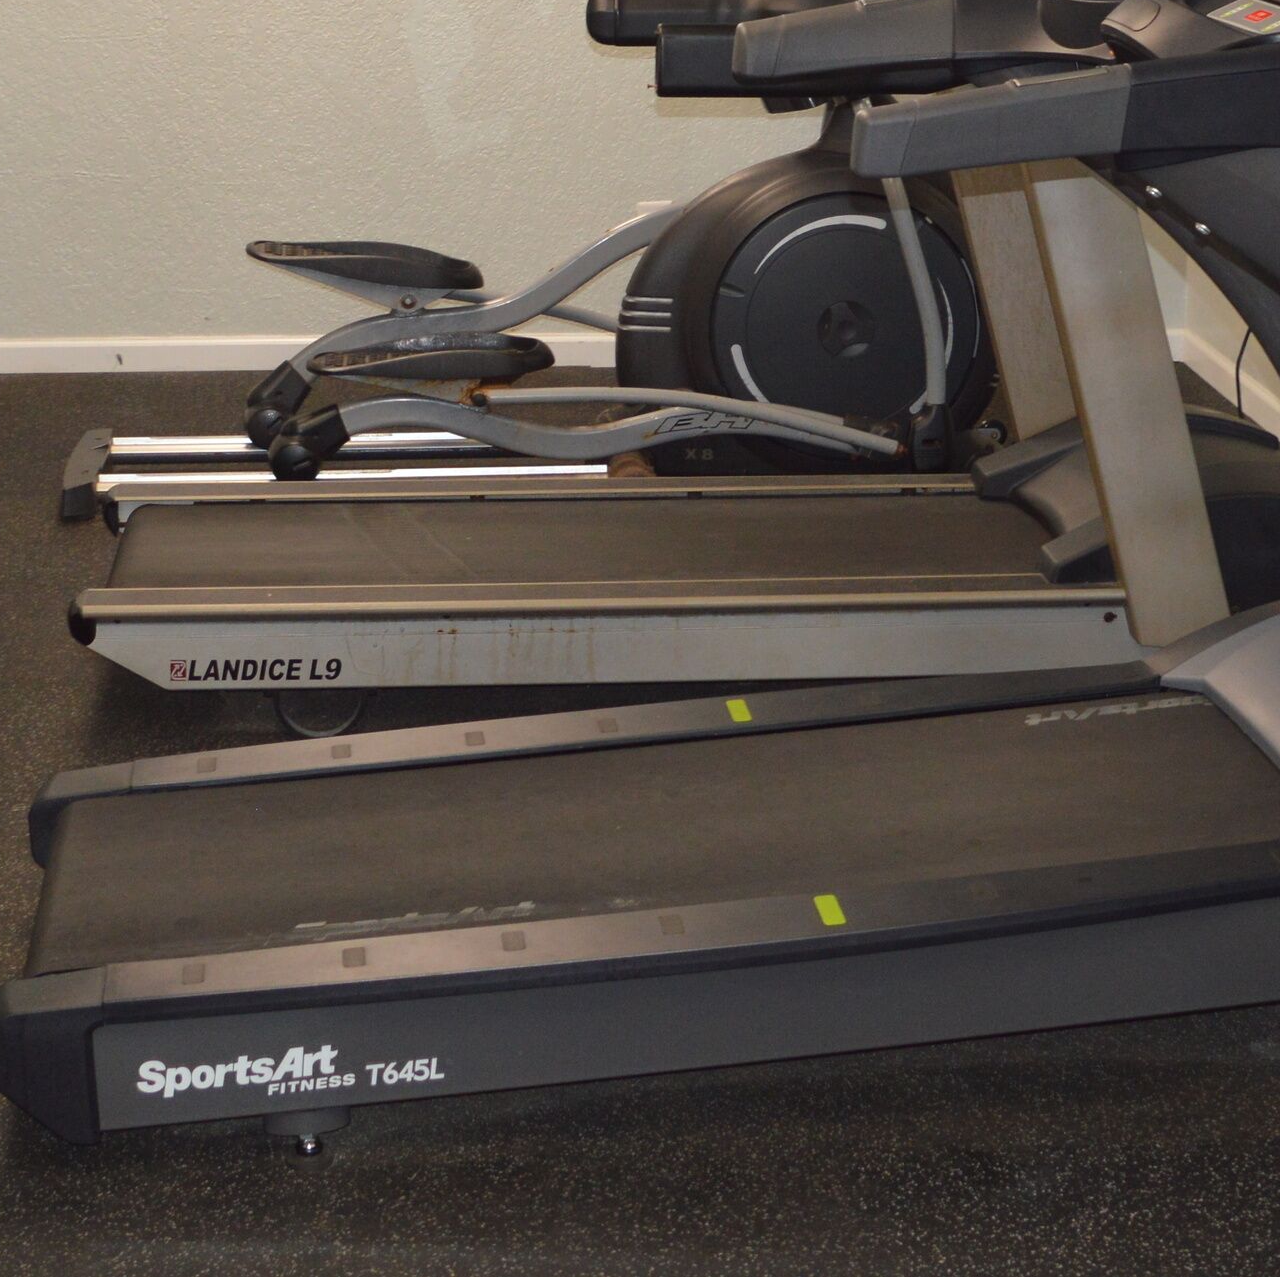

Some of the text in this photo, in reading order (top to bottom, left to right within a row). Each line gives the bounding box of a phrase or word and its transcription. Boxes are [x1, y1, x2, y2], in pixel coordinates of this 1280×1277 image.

[188, 658, 342, 681] LANDICE L9
[137, 1044, 445, 1098] SportsArt T645L
[268, 1073, 356, 1096] FITNESS
